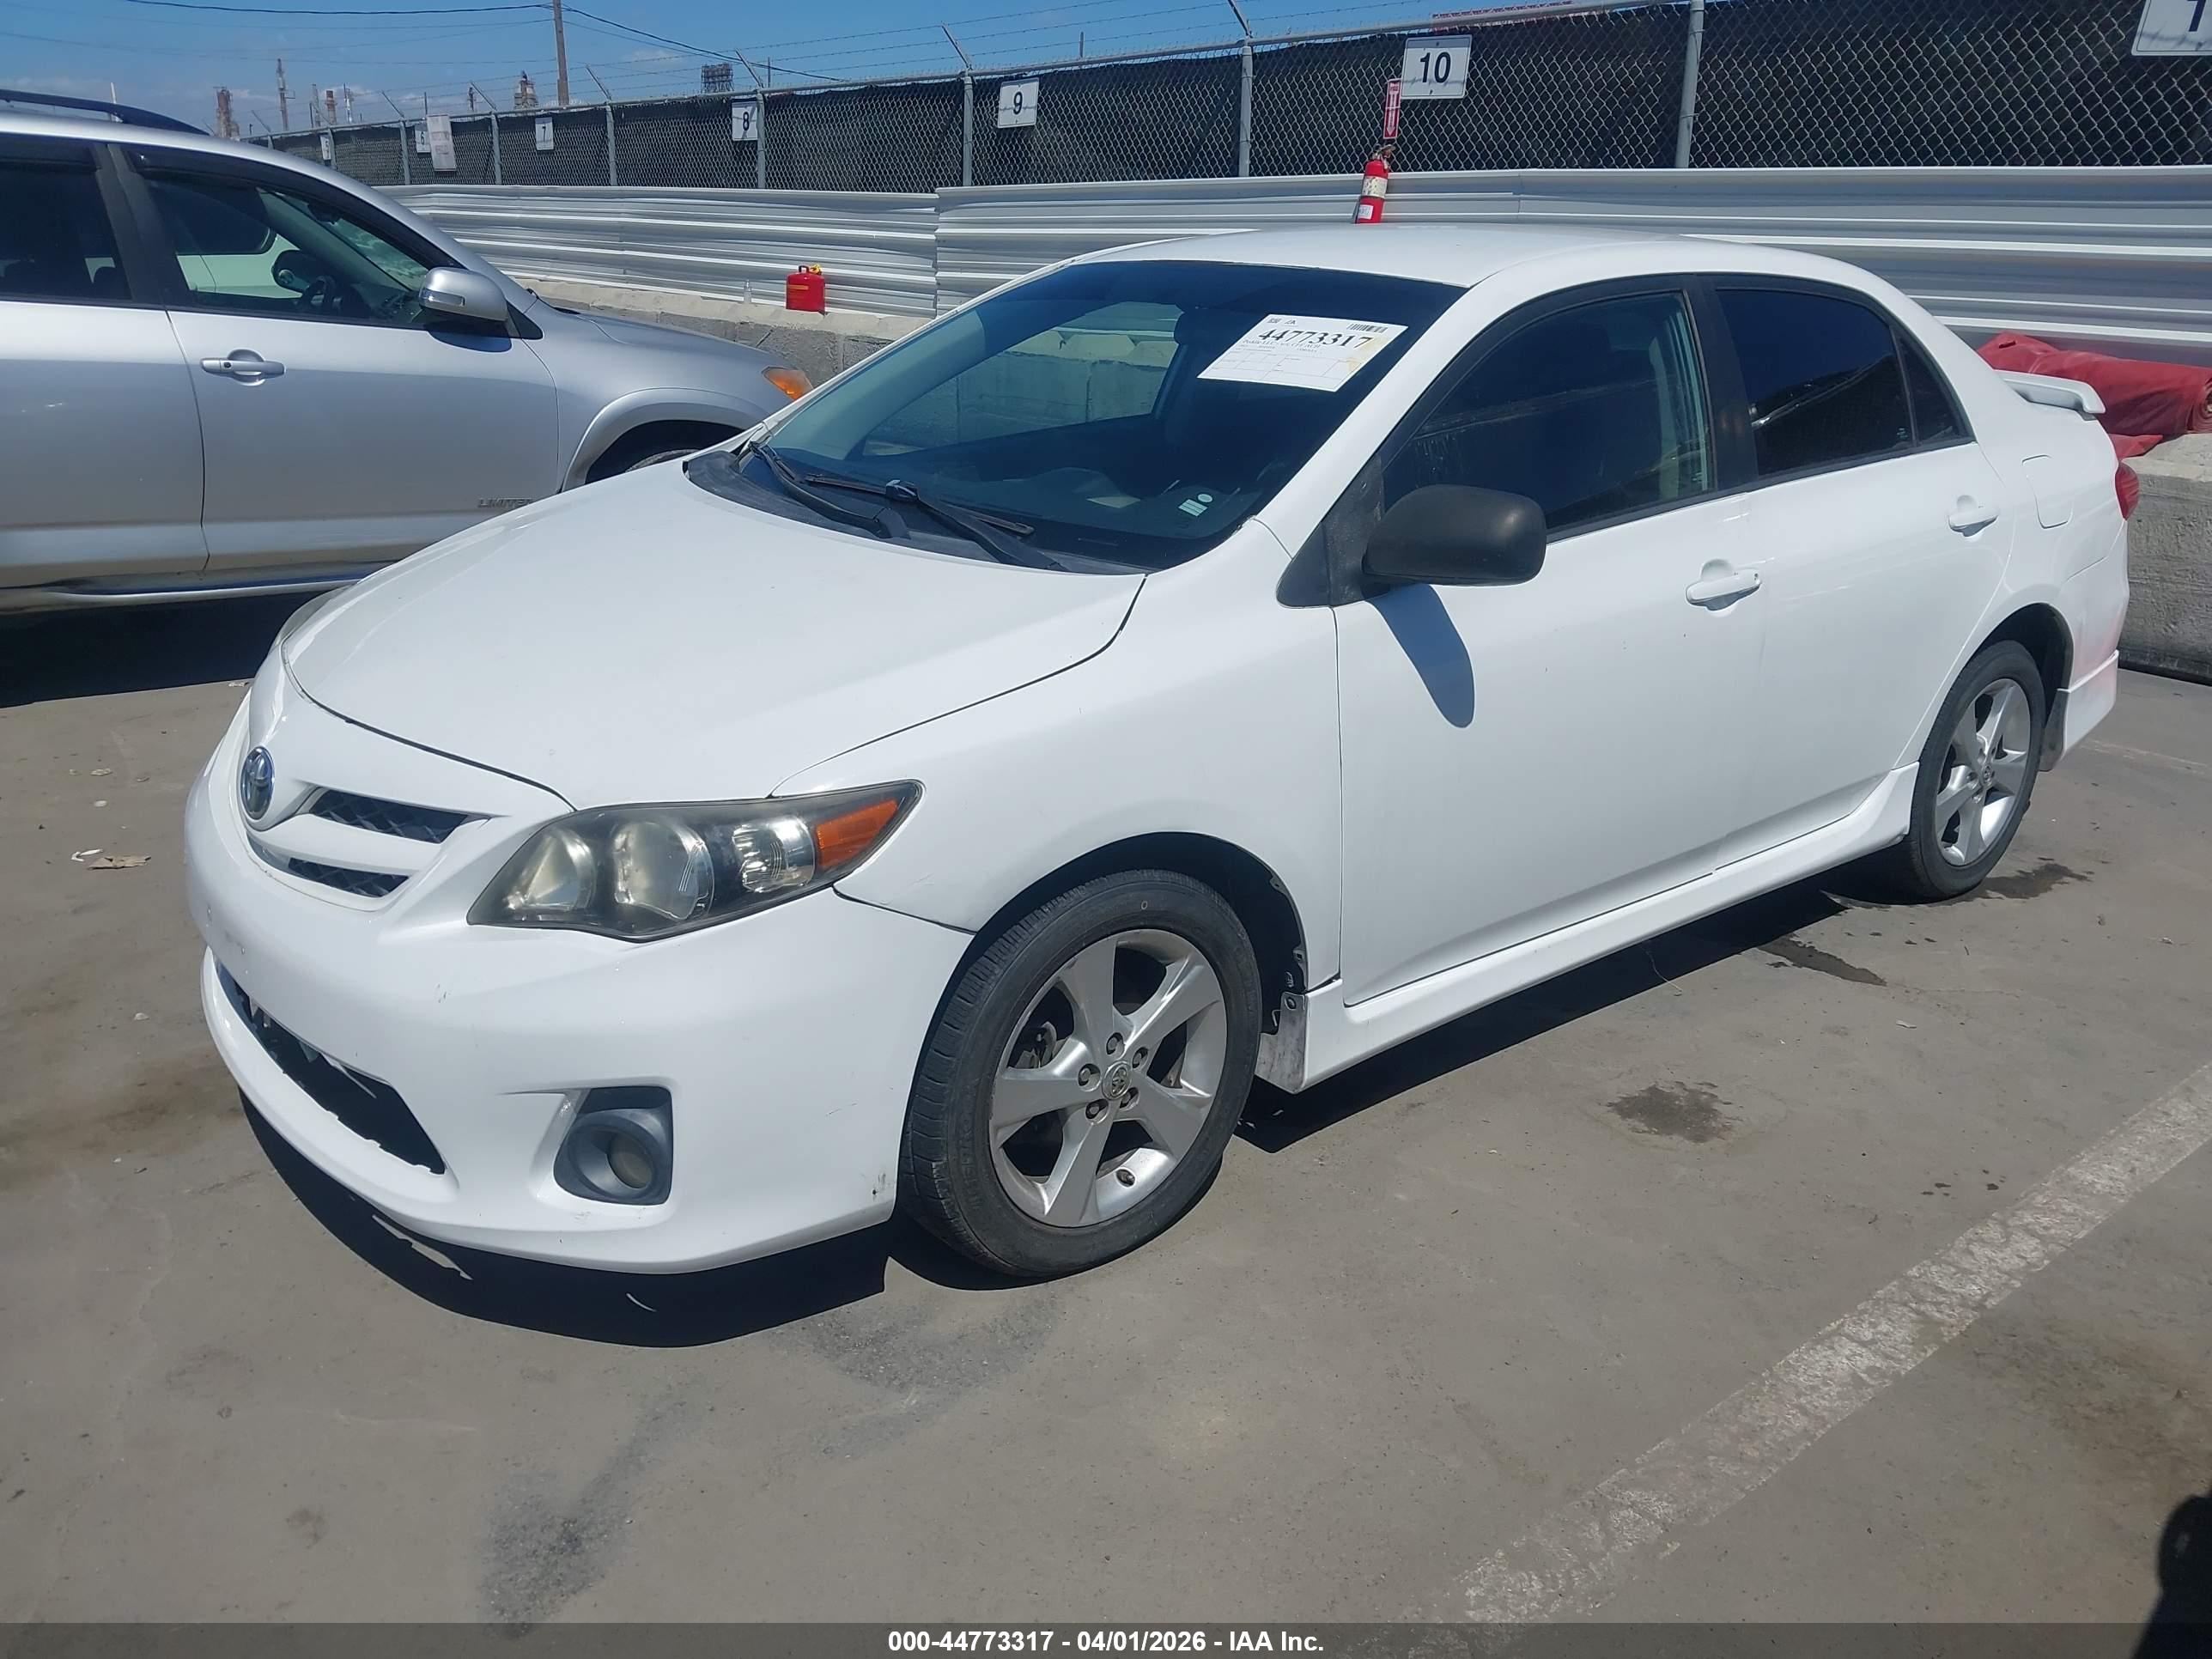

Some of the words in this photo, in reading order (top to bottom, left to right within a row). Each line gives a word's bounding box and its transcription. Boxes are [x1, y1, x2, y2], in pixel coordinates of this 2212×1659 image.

[1419, 52, 1451, 83] 10
[1013, 91, 1023, 115] 9
[742, 111, 750, 131] 8
[420, 131, 425, 145] 6
[542, 125, 547, 142] 7
[1258, 328, 1374, 349] 44773317
